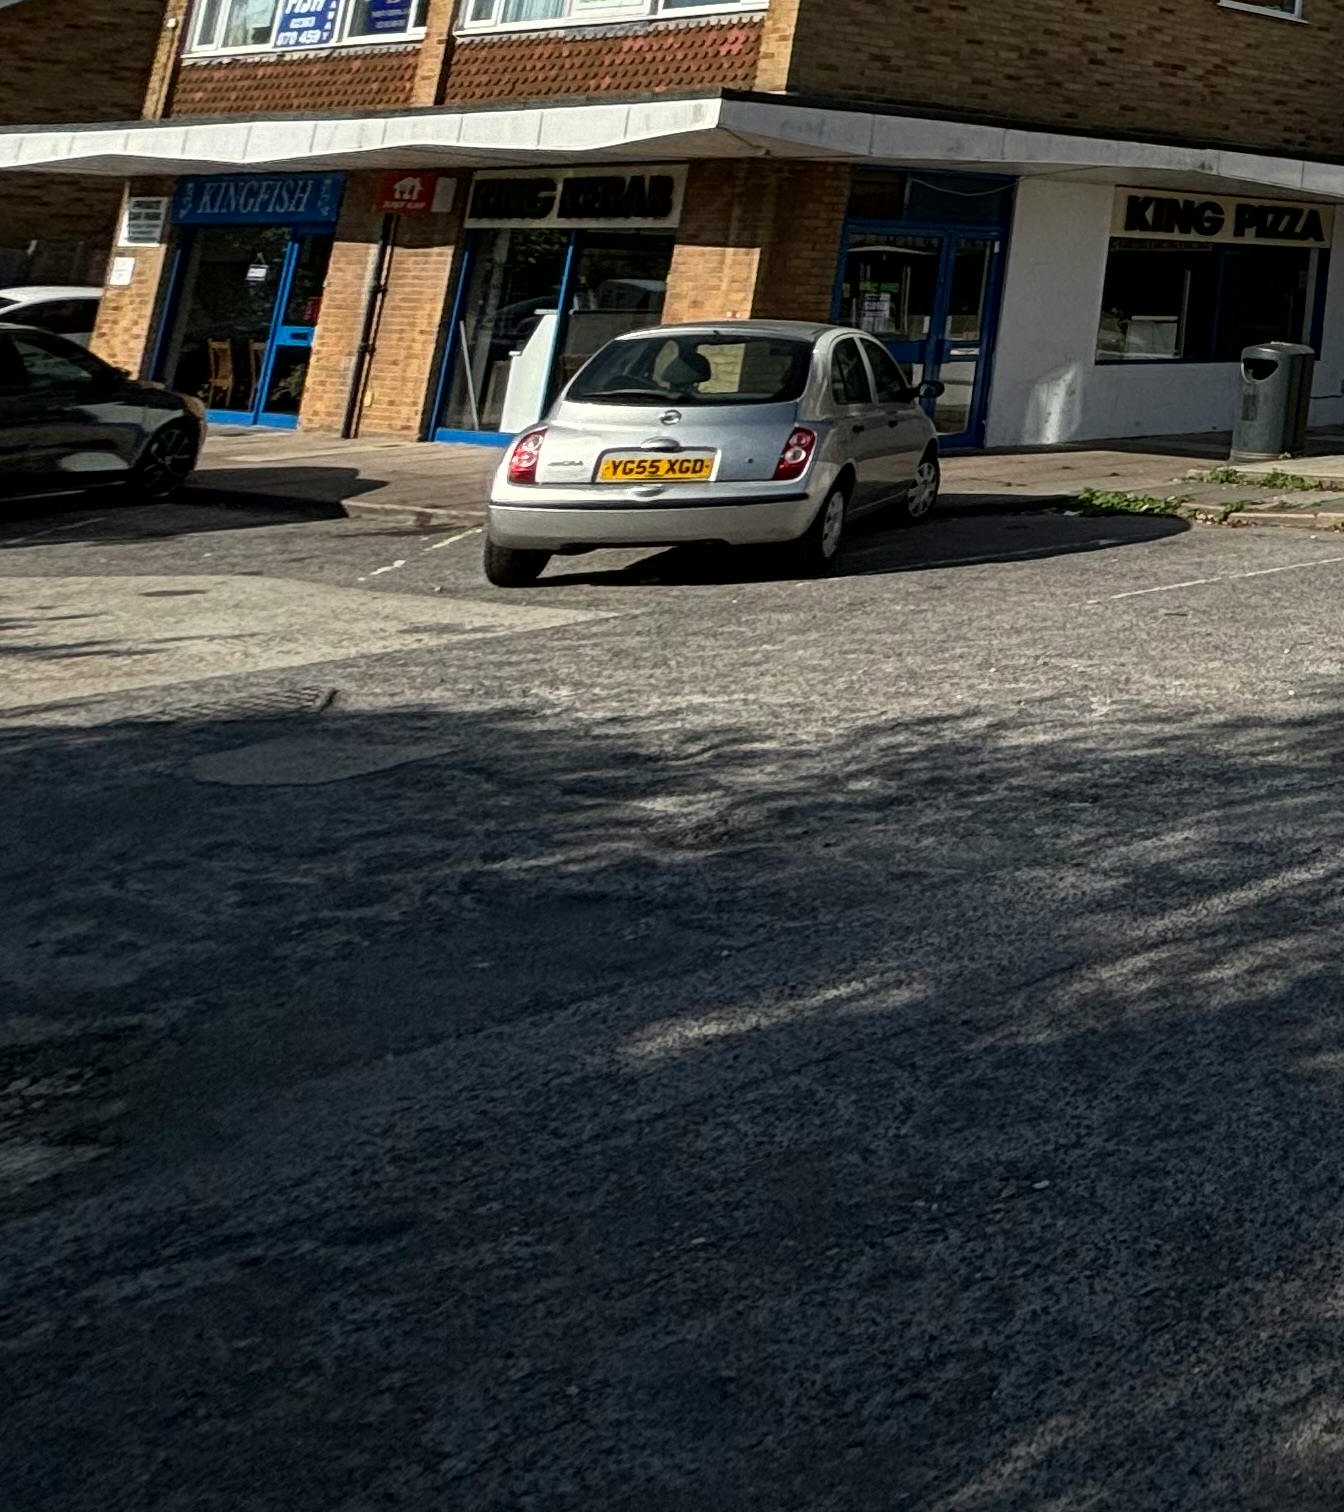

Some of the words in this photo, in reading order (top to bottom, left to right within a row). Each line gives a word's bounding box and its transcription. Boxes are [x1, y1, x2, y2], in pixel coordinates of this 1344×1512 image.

[196, 180, 315, 214] KINGFISH
[1124, 195, 1225, 236] KING
[1233, 203, 1325, 241] PIZZA
[610, 459, 661, 476] YG55
[665, 459, 705, 475] XGD
